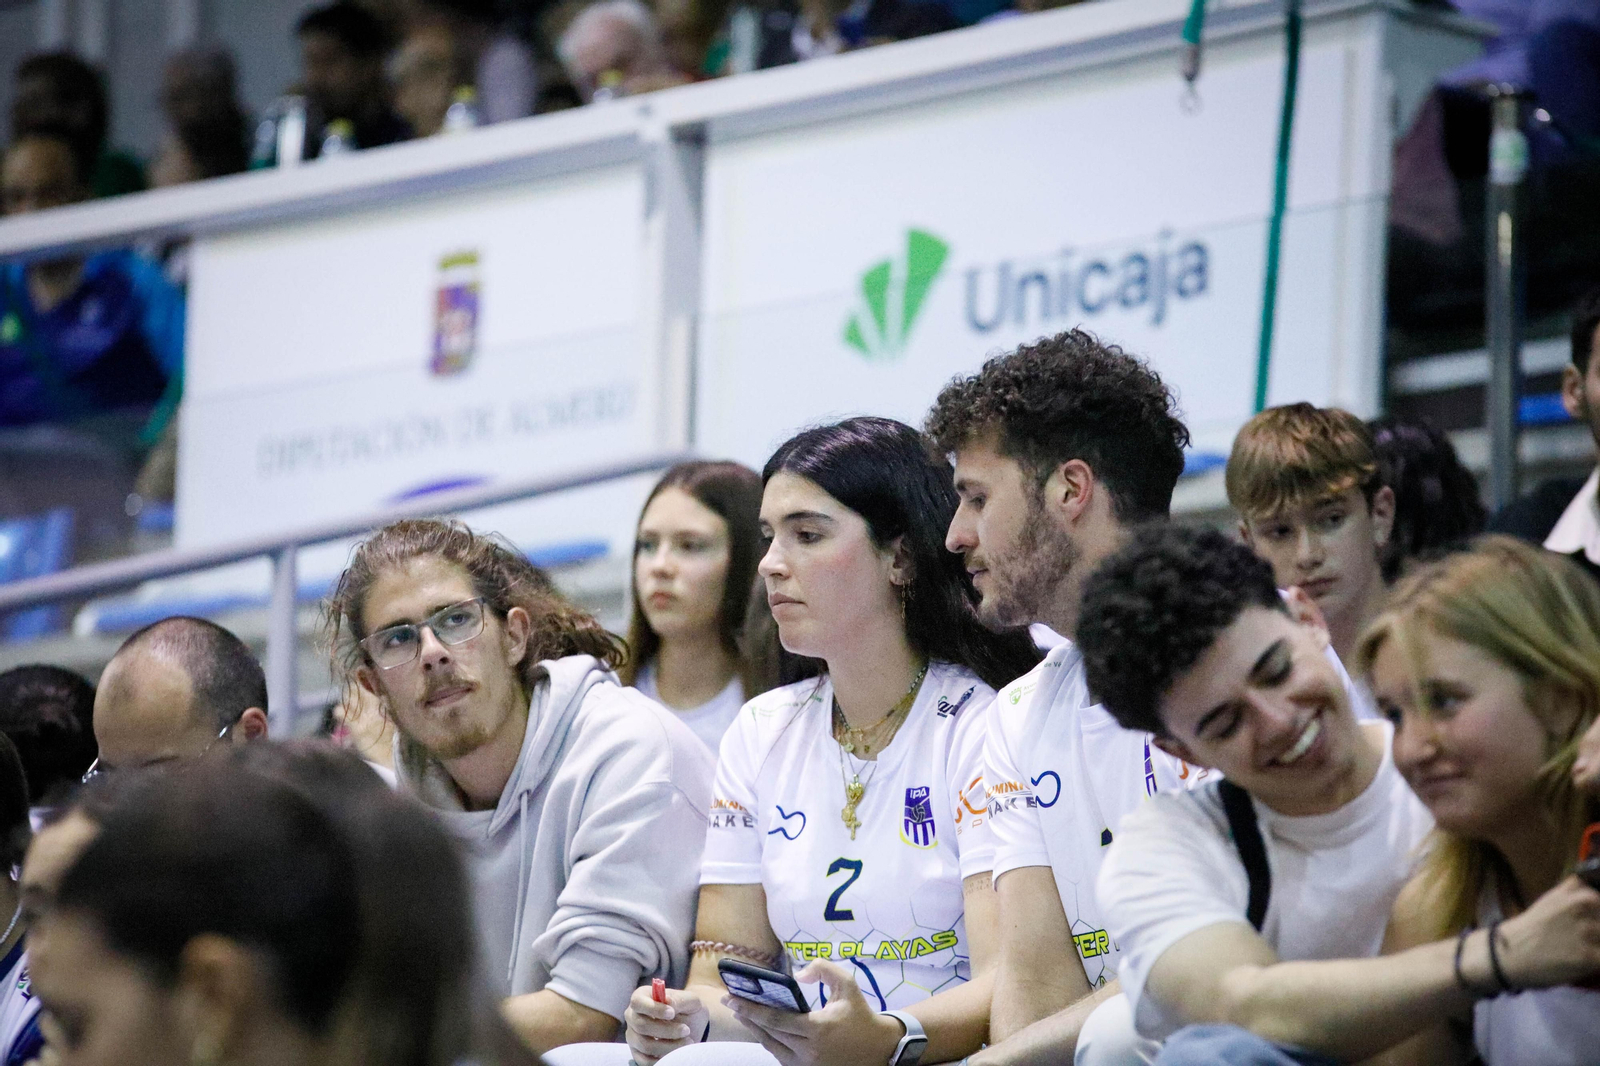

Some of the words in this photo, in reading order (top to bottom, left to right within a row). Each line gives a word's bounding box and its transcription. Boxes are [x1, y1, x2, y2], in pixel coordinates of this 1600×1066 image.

[966, 228, 1210, 332] Unicaja
[910, 787, 927, 800] IPA
[824, 857, 863, 922] 2
[839, 930, 958, 961] PLAYAS
